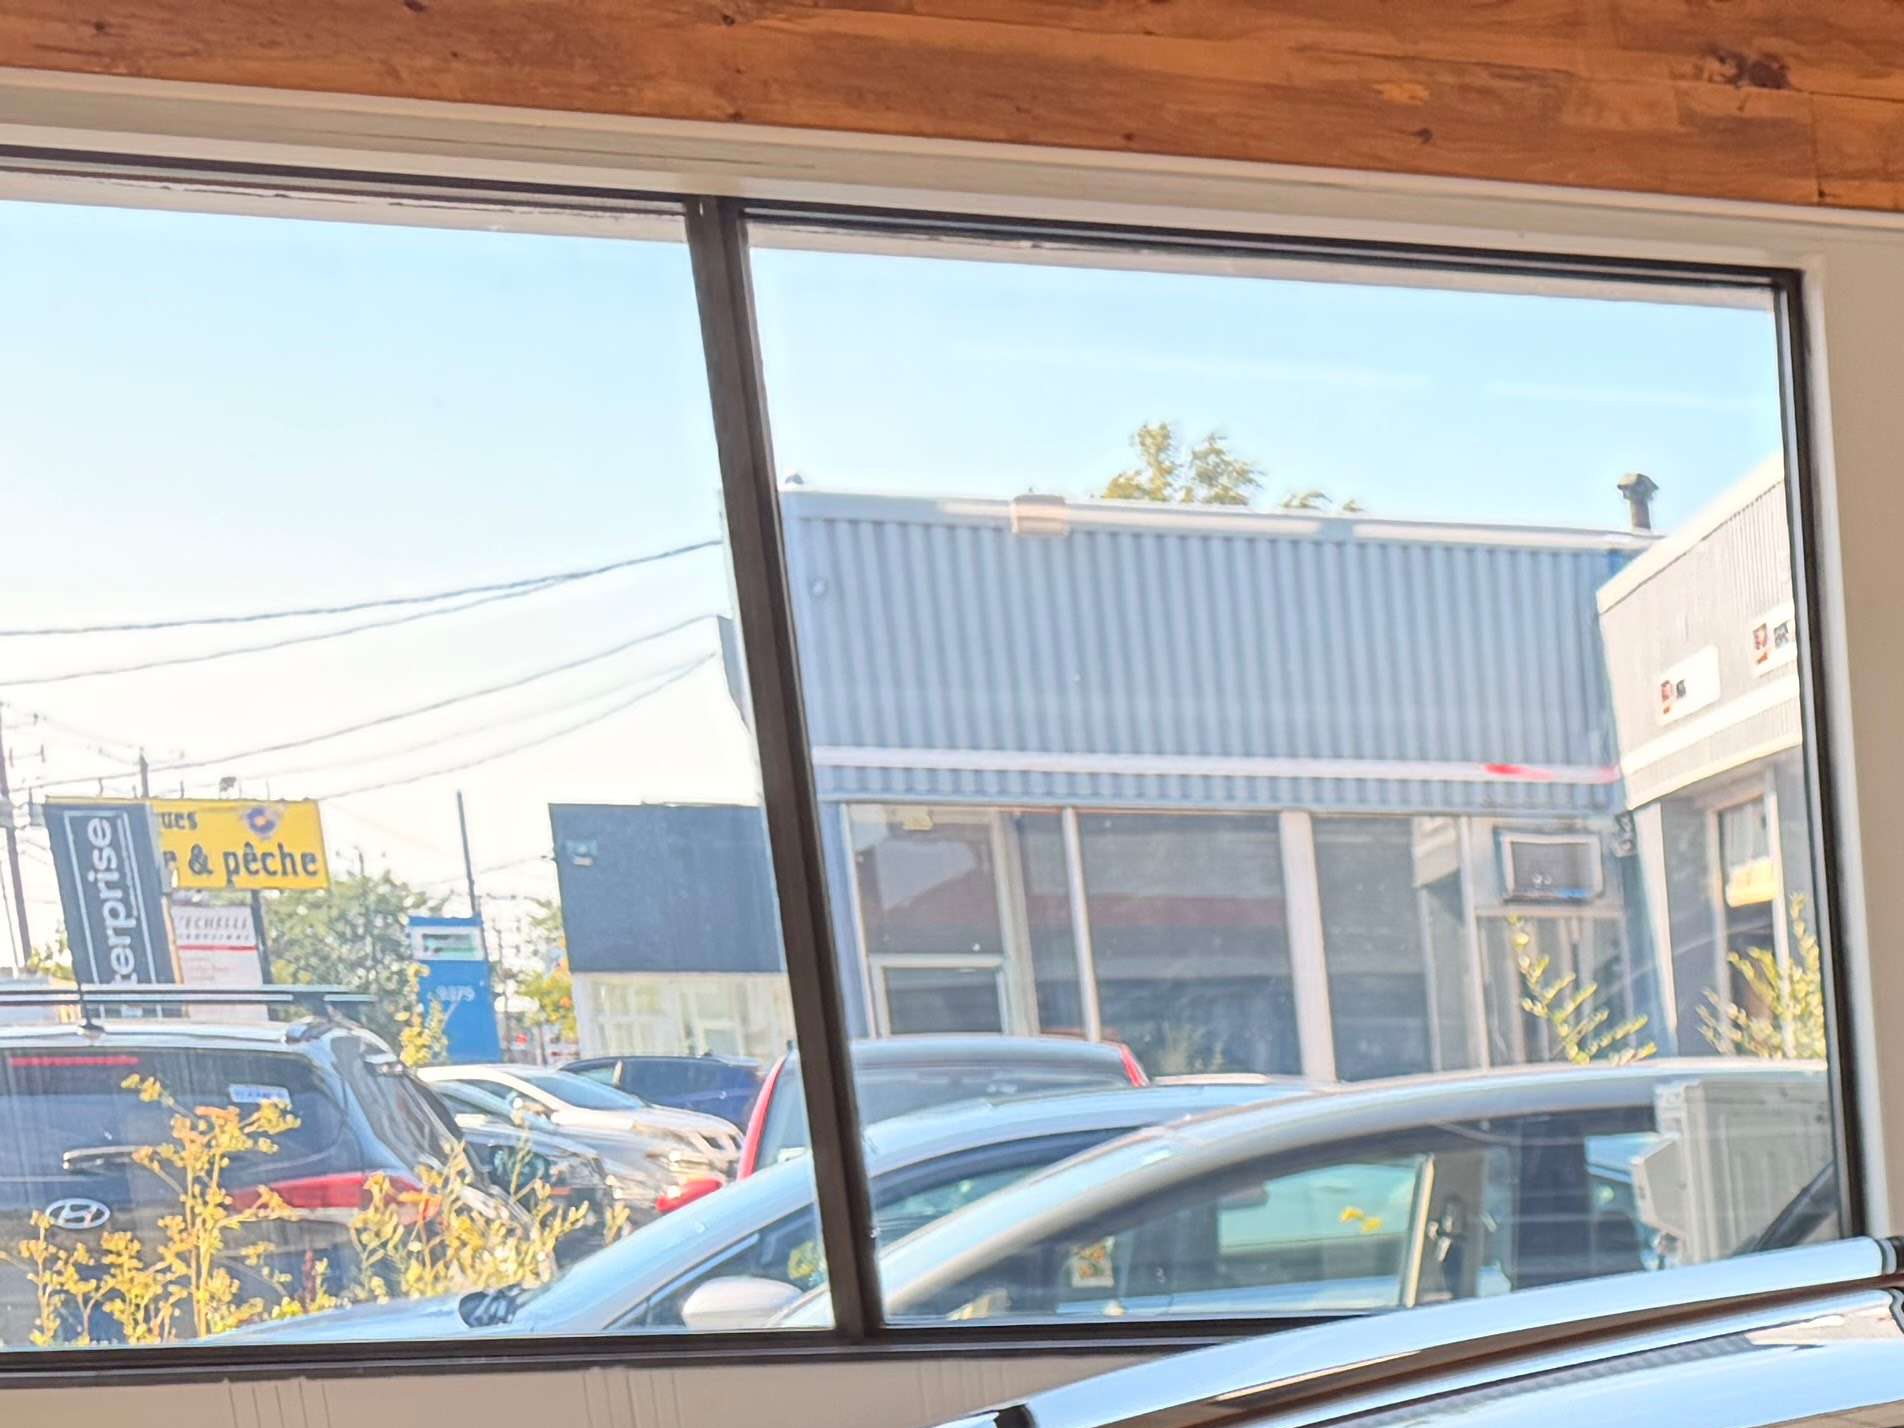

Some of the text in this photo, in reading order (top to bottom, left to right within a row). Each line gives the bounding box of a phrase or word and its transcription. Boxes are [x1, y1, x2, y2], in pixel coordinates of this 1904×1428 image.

[161, 811, 198, 830] ues
[223, 842, 320, 888] pêche
[87, 817, 142, 1017] terprise
